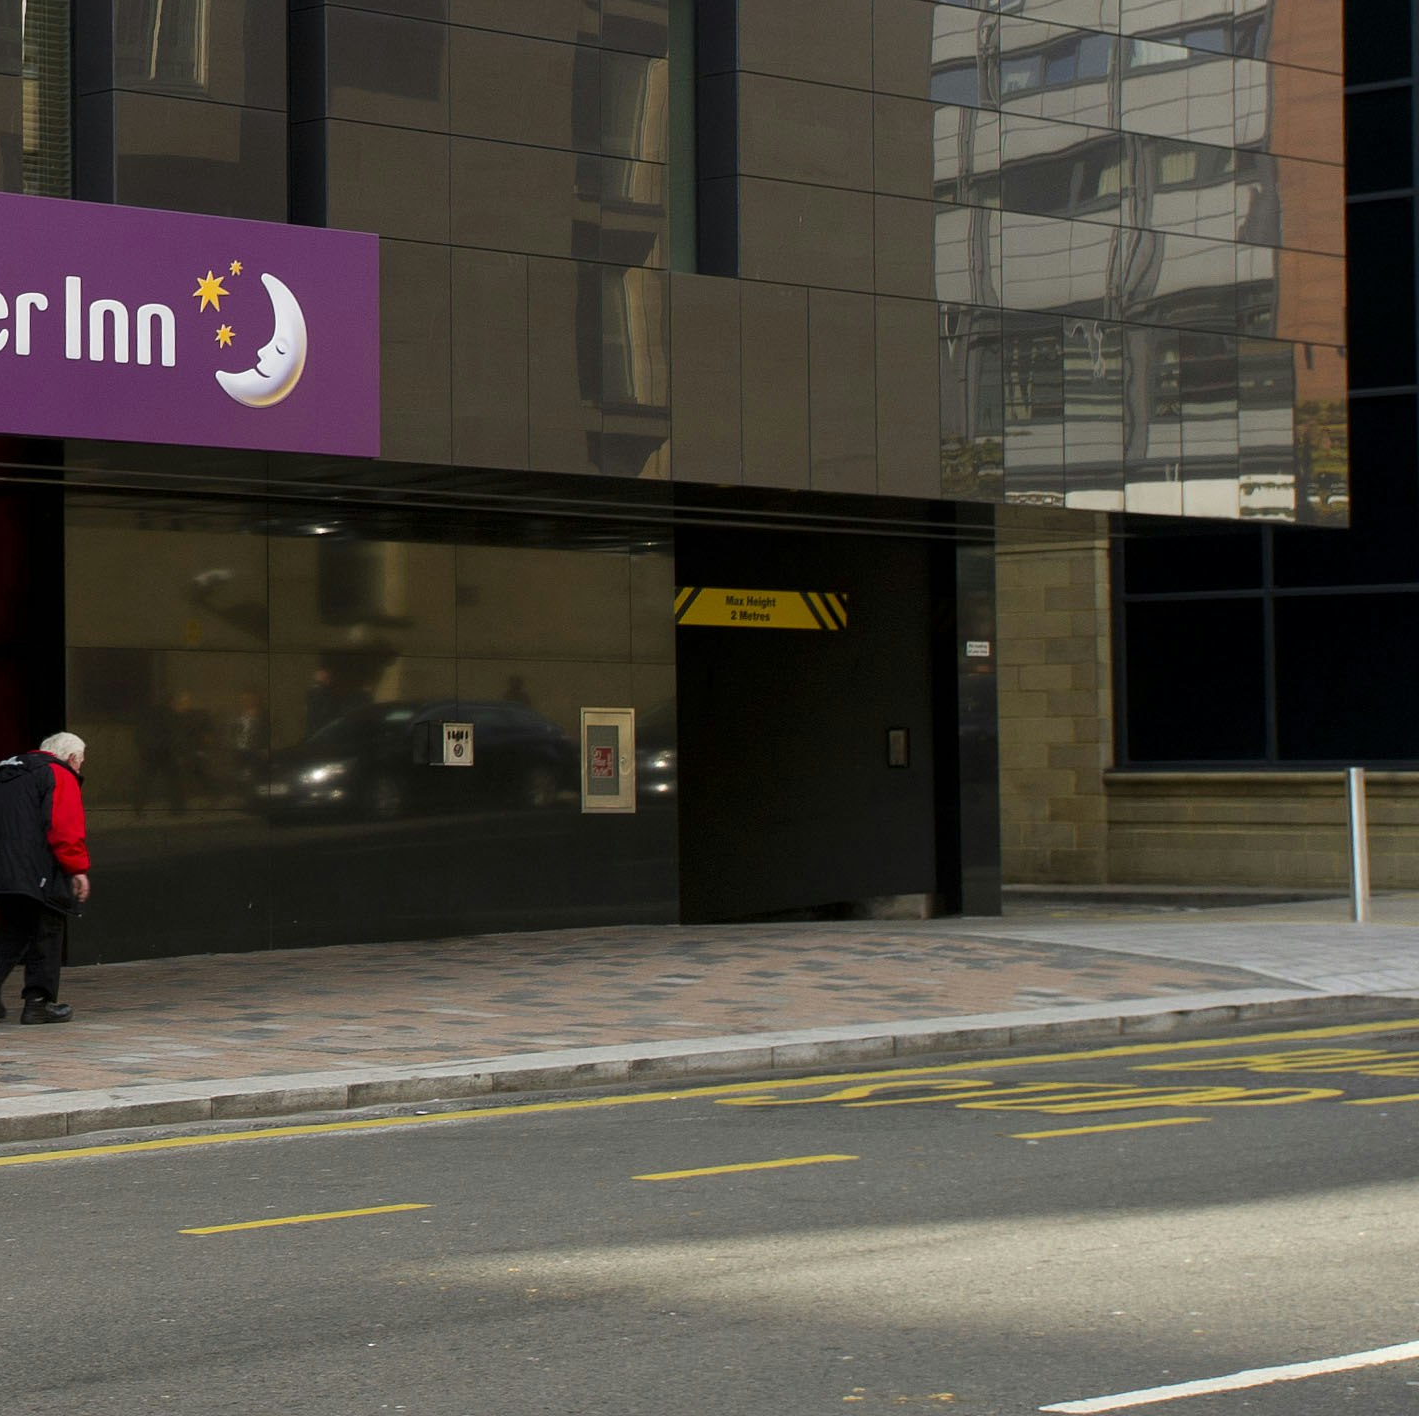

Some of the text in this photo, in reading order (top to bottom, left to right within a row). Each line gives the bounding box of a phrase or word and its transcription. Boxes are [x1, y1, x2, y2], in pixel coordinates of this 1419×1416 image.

[64, 275, 177, 368] Inn
[725, 595, 776, 609] Max Height
[730, 610, 771, 622] 2 Metres
